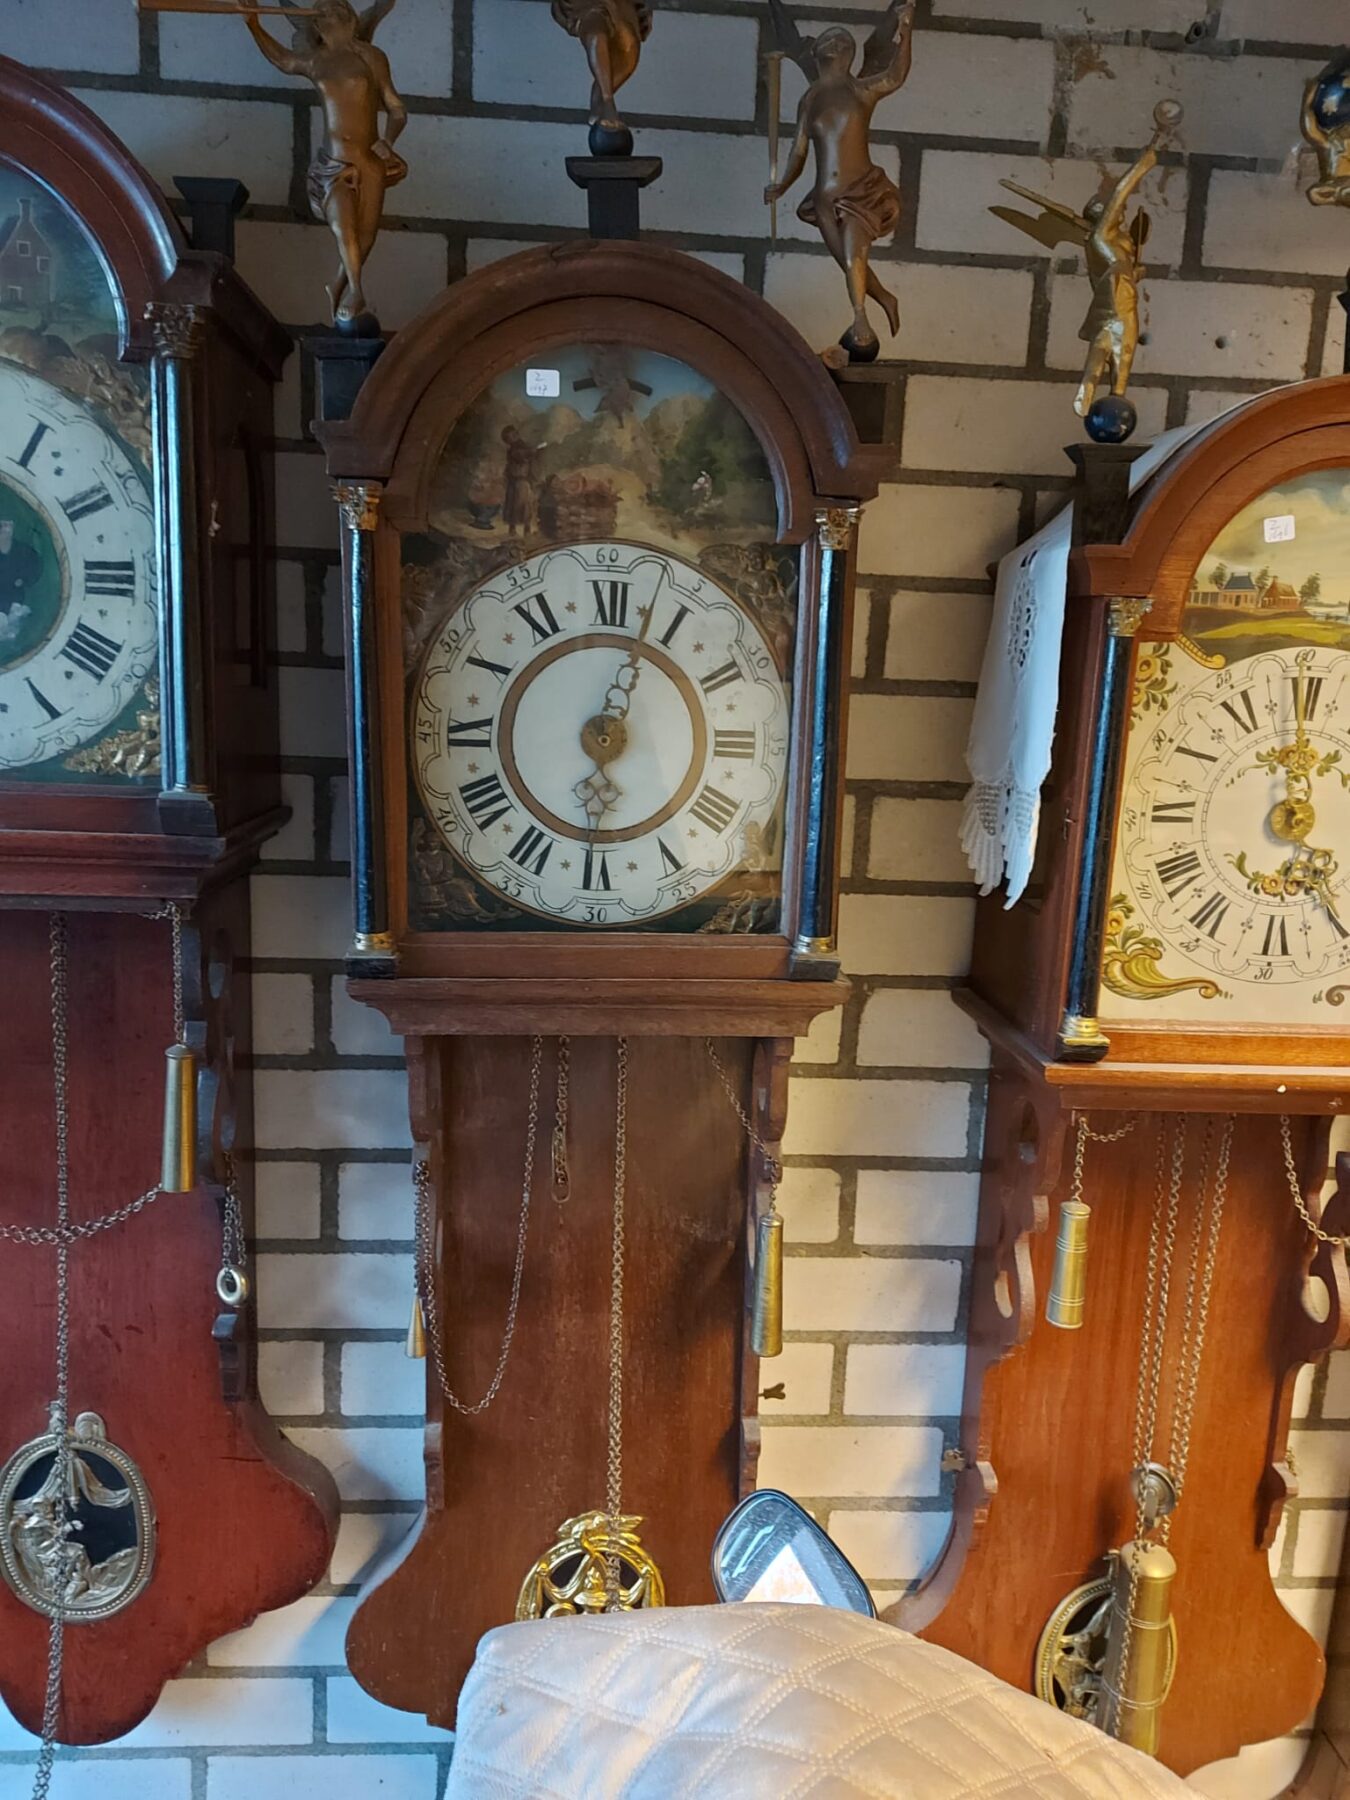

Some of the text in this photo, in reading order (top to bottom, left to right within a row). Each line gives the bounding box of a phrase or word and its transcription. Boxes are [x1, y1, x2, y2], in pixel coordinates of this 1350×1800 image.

[596, 547, 619, 564] 60
[506, 565, 531, 587] 55
[692, 578, 707, 593] 5
[586, 580, 632, 628] XII
[510, 592, 567, 646] XI
[439, 629, 460, 654] 50
[462, 639, 518, 685] X
[417, 717, 433, 743] 45
[711, 721, 757, 767] III
